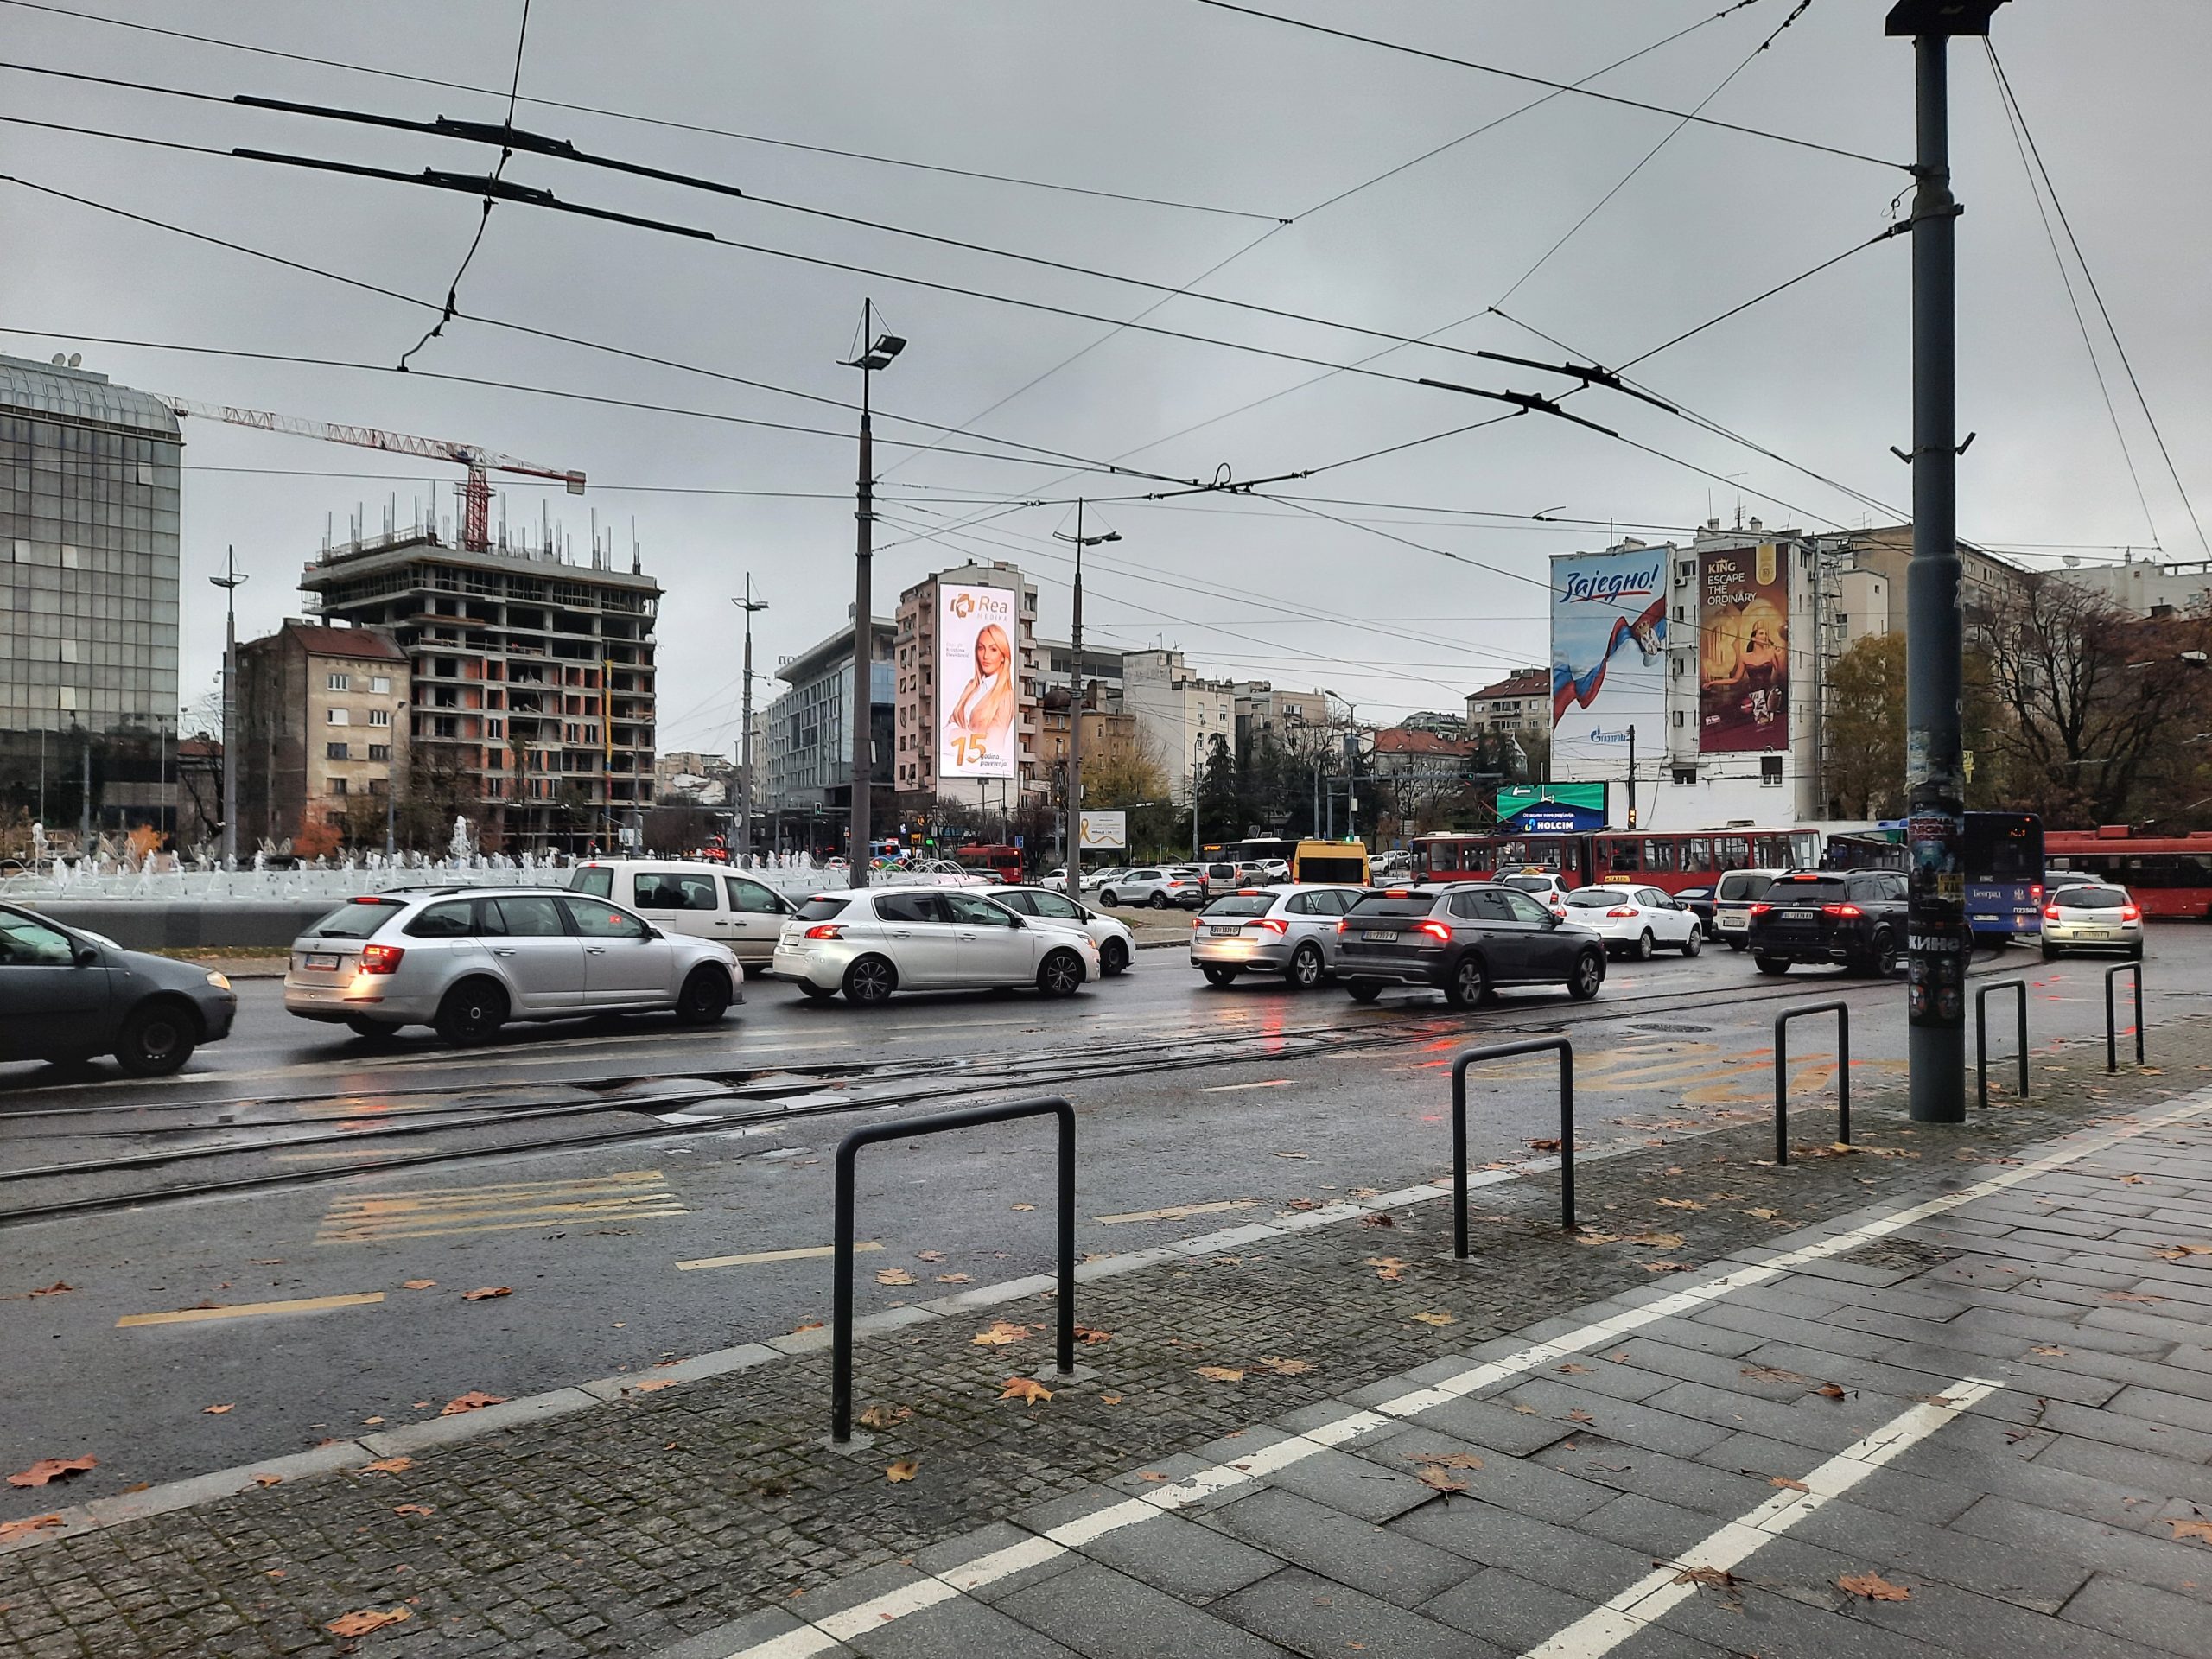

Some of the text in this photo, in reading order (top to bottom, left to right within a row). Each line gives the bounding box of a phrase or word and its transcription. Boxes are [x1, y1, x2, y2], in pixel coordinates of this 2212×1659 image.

[1708, 562, 1736, 574] KING
[1559, 563, 1659, 604] Заједно!
[1707, 573, 1745, 585] ESCAPE
[1707, 585, 1727, 594] THE
[978, 595, 1007, 614] Rea
[1707, 592, 1757, 607] ORDINARY
[951, 733, 988, 766] 15
[1537, 821, 1573, 830] HOLCIM
[1973, 888, 2002, 899] Београд
[1908, 934, 1961, 951] КИНО
